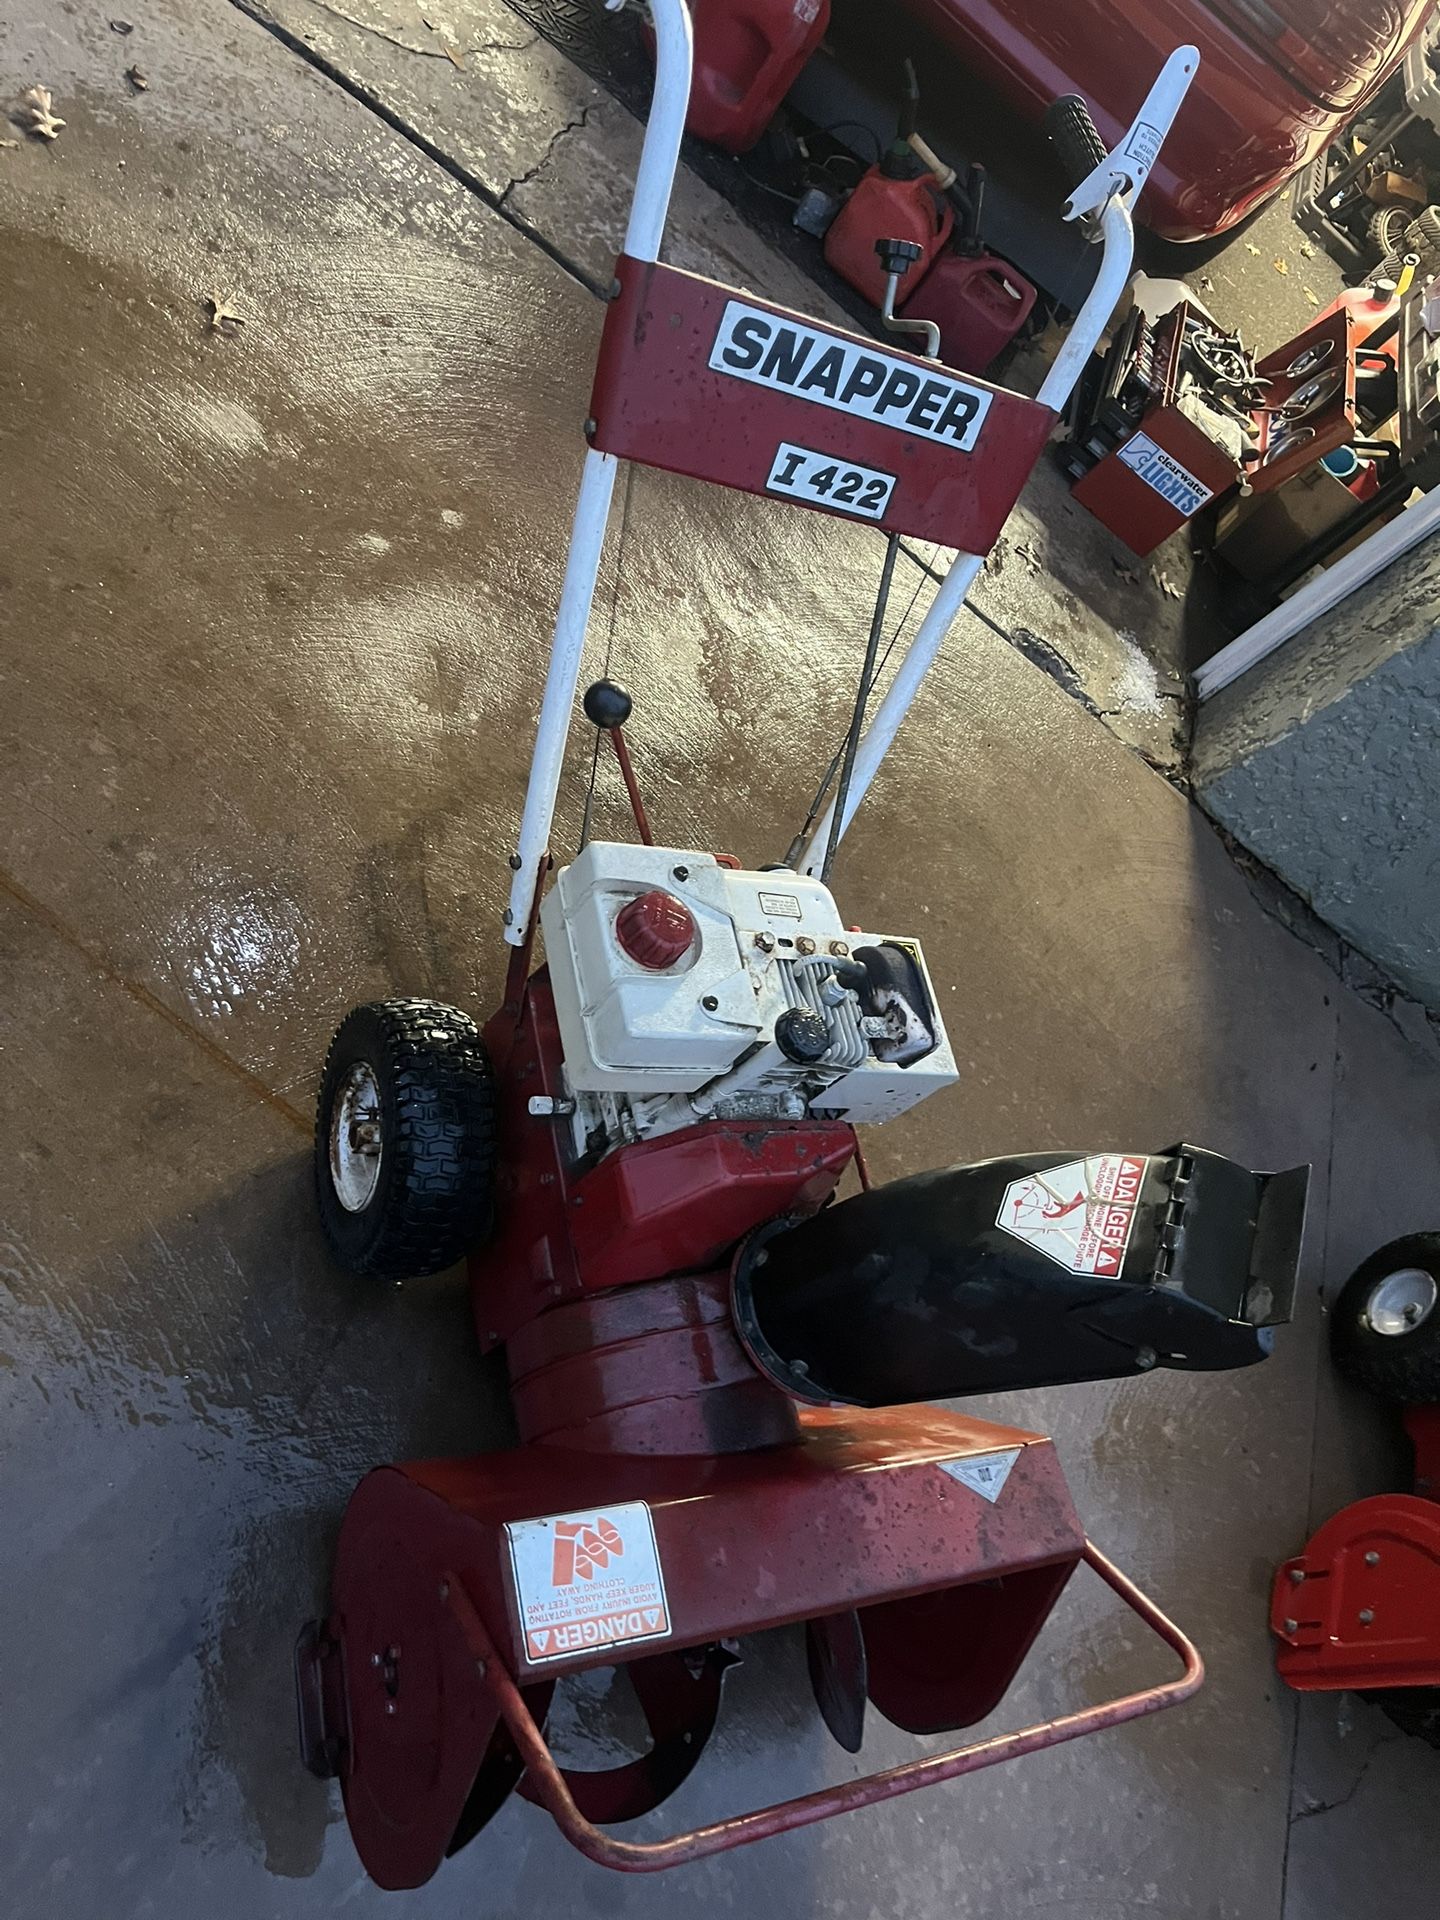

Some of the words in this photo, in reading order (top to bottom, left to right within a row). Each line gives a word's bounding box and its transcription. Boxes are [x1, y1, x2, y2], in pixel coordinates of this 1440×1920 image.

[722, 315, 980, 441] SNAPPER
[773, 452, 807, 486] I
[808, 465, 888, 511] 422
[1157, 453, 1208, 498] clearwater
[1140, 461, 1201, 513] LIGHTS
[1105, 1166, 1117, 1184] SHUT
[1093, 1200, 1106, 1228] NGINE
[556, 1585, 581, 1596] AWAY
[583, 1576, 625, 1591] CLOTHING
[629, 1583, 656, 1594] AUGER
[605, 1587, 627, 1599] KEEP
[633, 1592, 658, 1603] AVOID
[527, 1602, 545, 1613] AND
[548, 1598, 569, 1610] FEET
[575, 1603, 599, 1615] FROM
[602, 1596, 631, 1610] INJURY
[528, 1608, 572, 1624] ROTATING
[554, 1611, 642, 1649] DANGER
